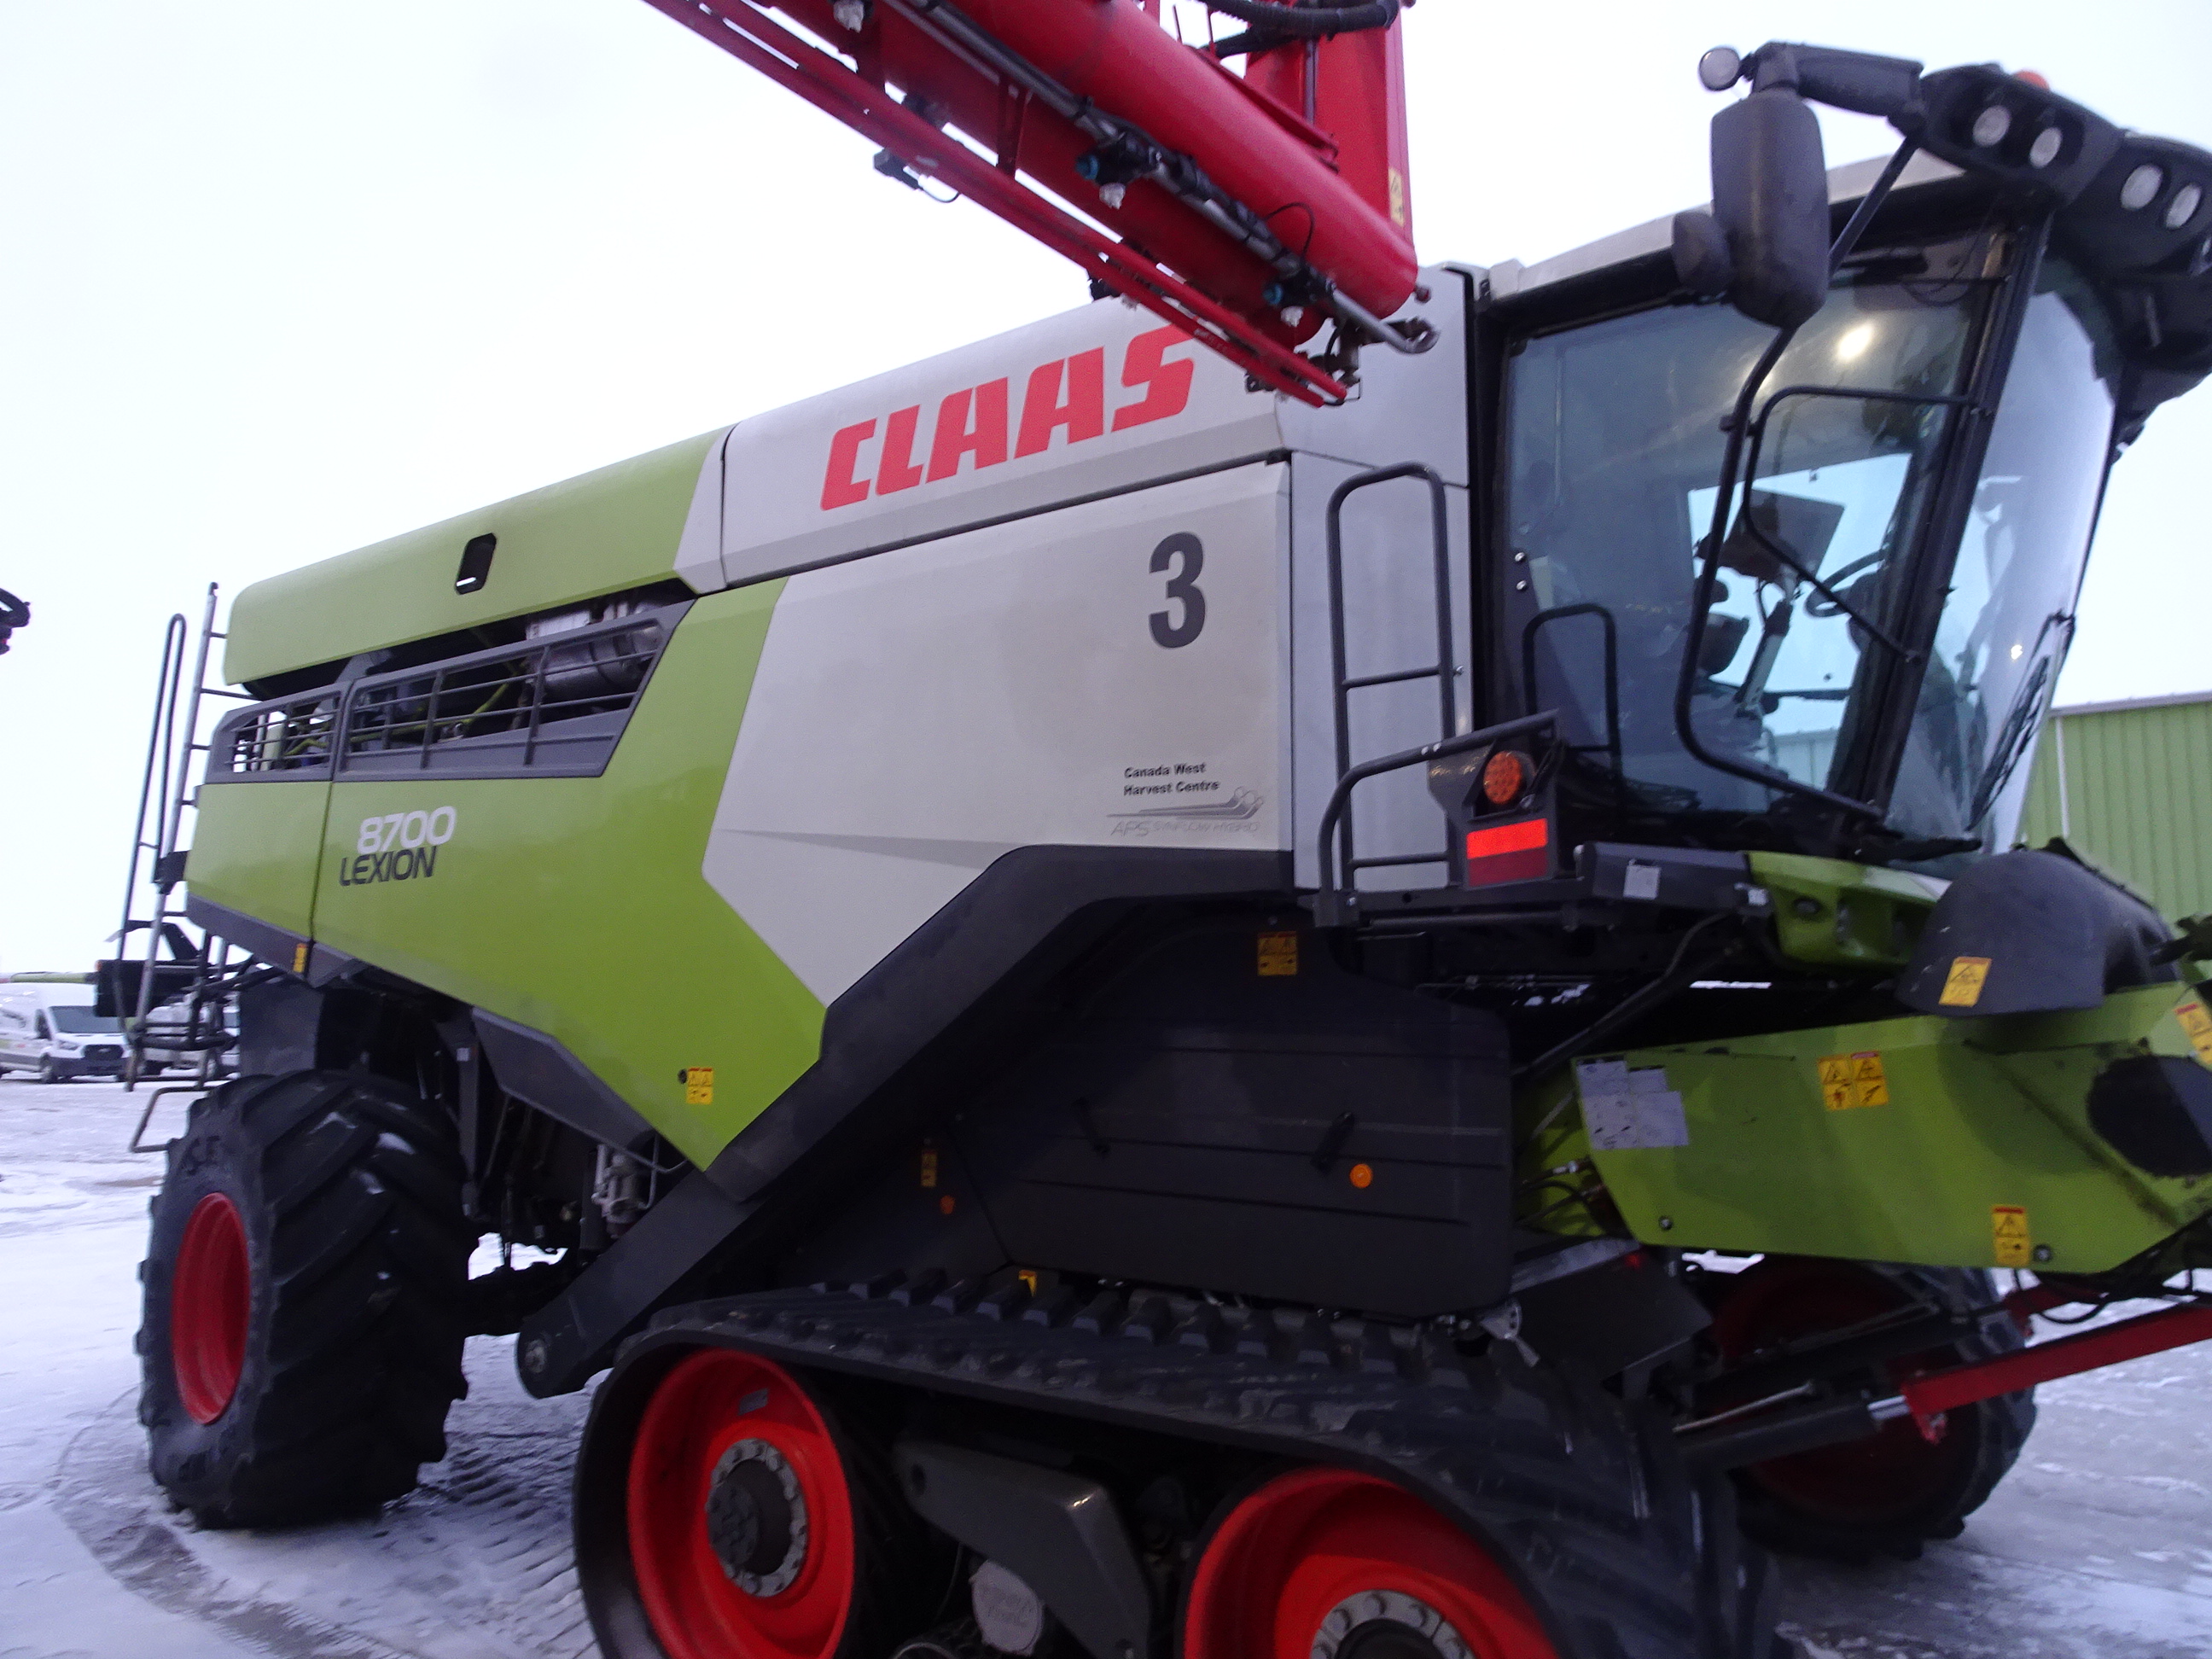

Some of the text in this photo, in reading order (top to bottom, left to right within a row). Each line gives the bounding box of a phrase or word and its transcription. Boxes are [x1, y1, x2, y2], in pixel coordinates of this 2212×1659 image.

[820, 323, 1195, 511] CLAAS
[1149, 532, 1206, 649] 3
[1123, 761, 1207, 779] Canada West
[1123, 779, 1220, 796] Harvest Centre
[357, 806, 457, 854] 8700
[339, 845, 438, 887] LEXION
